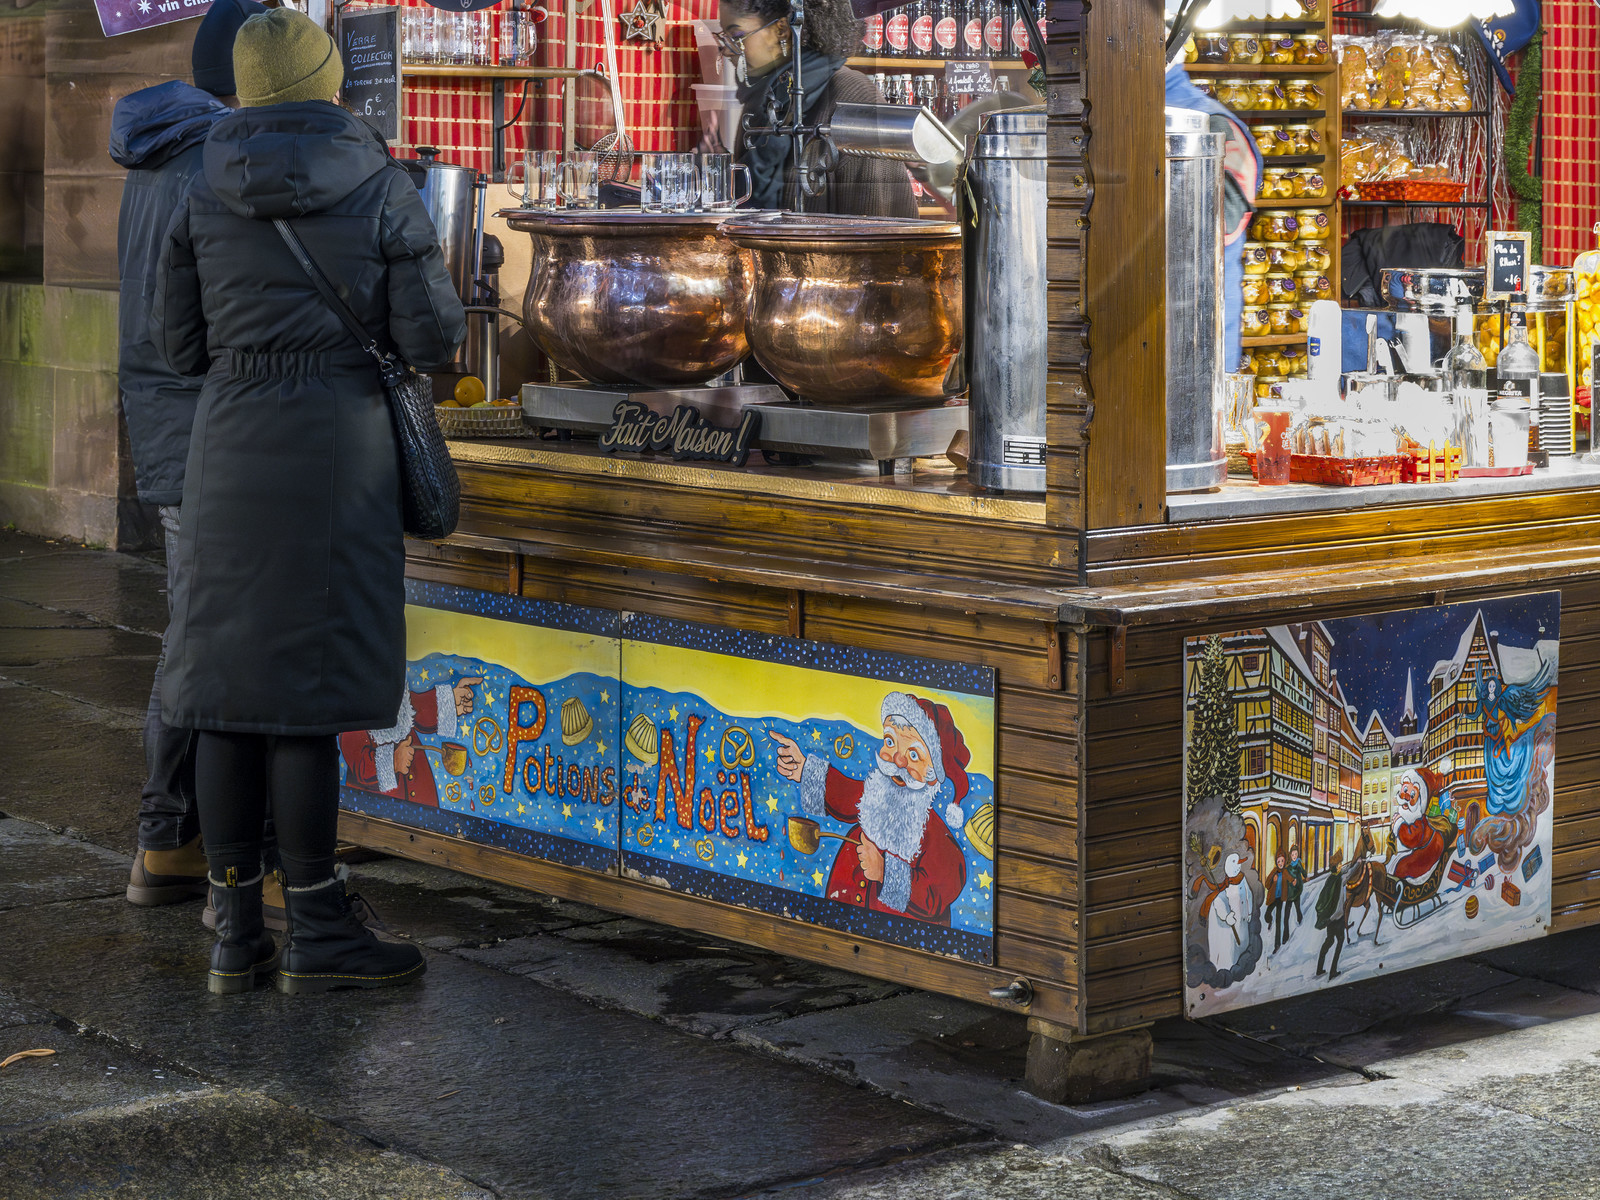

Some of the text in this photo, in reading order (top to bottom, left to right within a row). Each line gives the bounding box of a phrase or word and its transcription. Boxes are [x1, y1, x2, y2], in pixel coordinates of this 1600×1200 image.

[158, 0, 180, 13] vin
[351, 50, 393, 64] COLLECTOR
[601, 403, 655, 447] Fait
